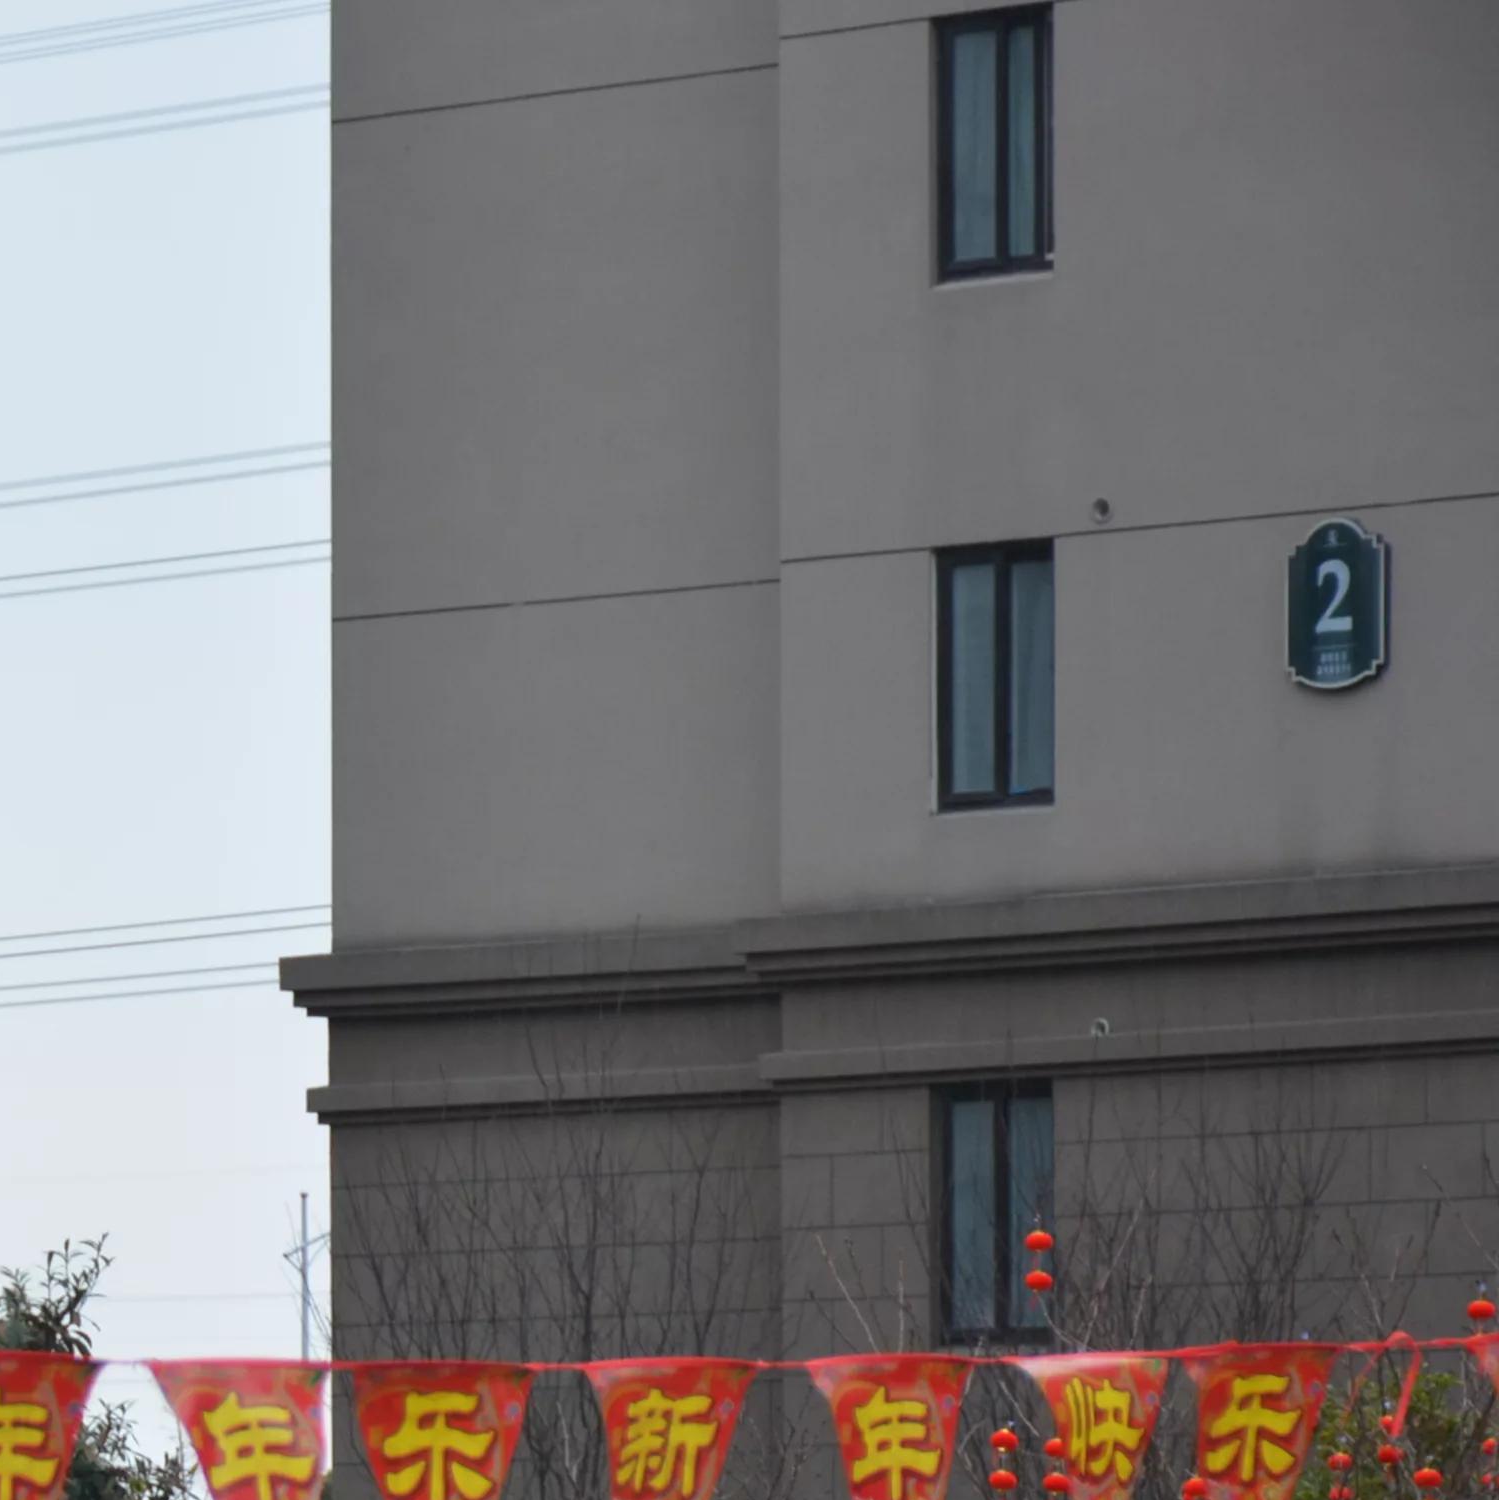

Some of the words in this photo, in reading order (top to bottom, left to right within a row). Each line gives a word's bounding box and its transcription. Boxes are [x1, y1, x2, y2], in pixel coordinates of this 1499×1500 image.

[1314, 558, 1353, 634] 2
[616, 1389, 718, 1497] 新
[1064, 1377, 1144, 1482] 快
[1206, 1373, 1301, 1481] 乐
